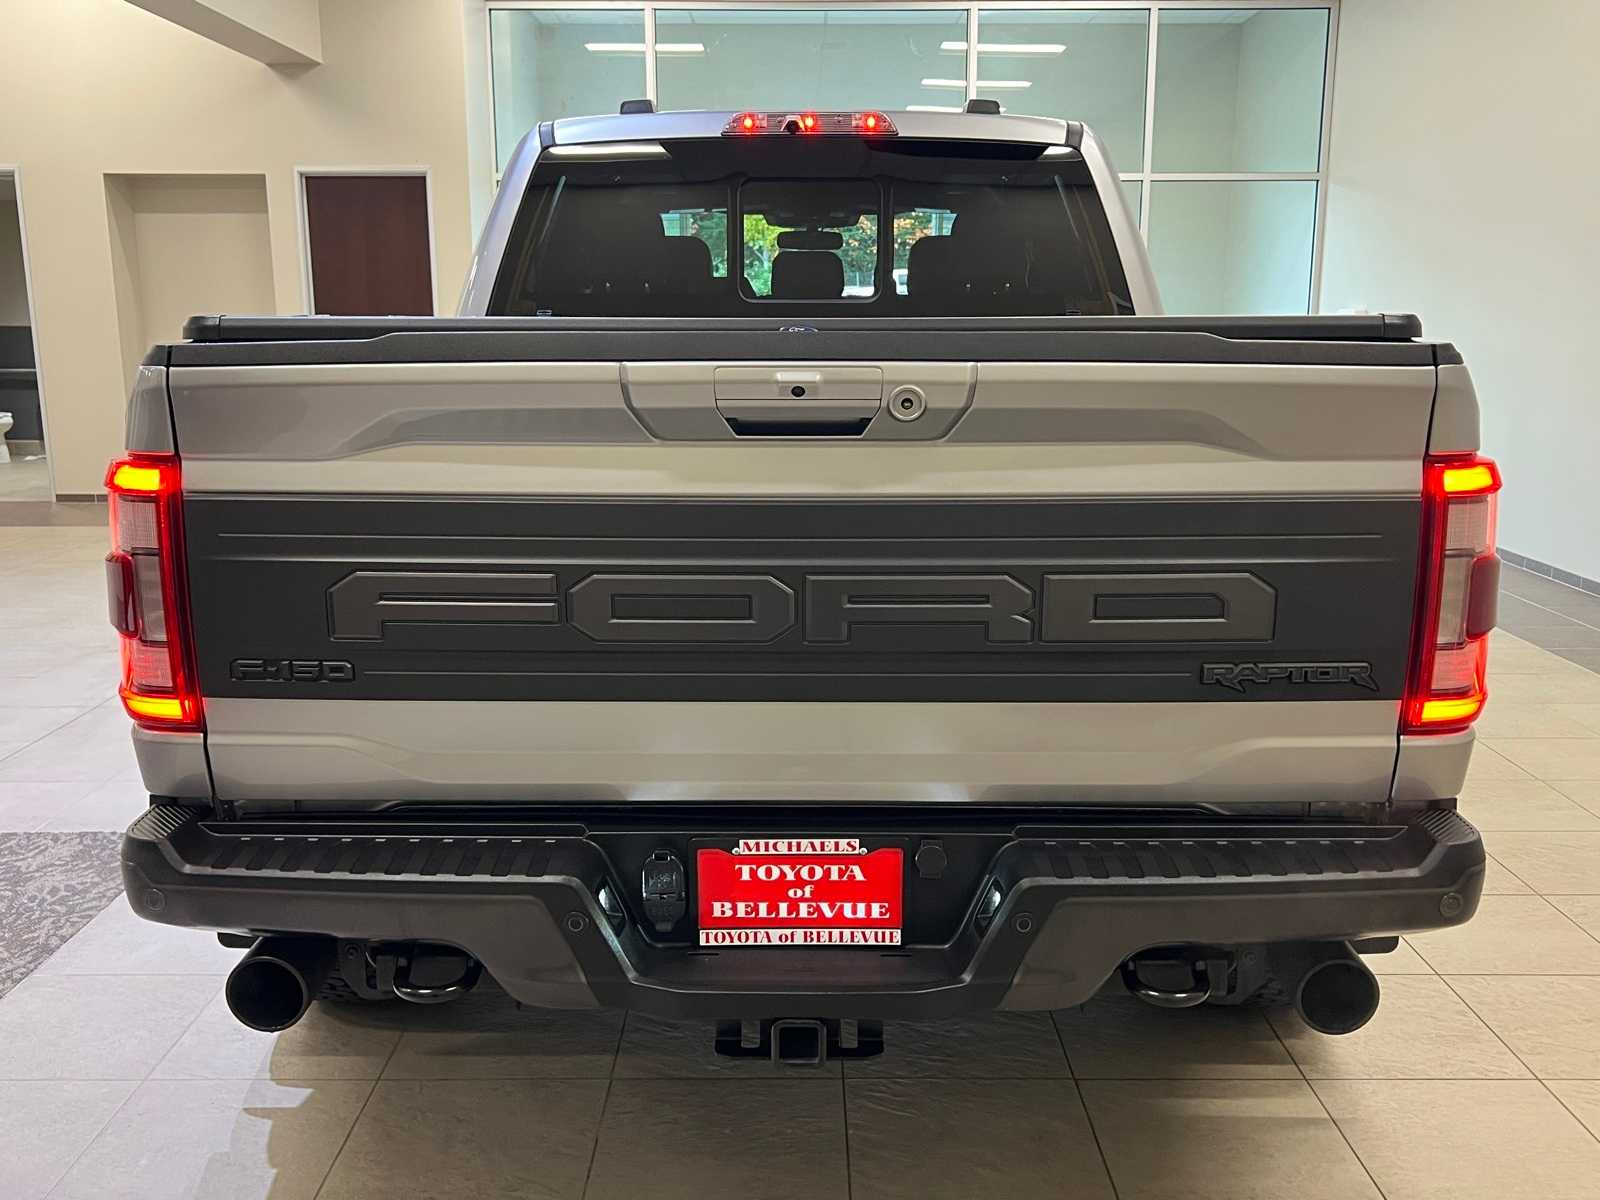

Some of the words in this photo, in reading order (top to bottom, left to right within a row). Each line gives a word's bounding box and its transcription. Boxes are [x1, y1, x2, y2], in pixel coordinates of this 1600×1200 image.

[328, 570, 1277, 644] FORD
[231, 659, 355, 681] F-150
[1202, 661, 1378, 691] RAPTOR
[742, 840, 858, 852] MICHAELS
[735, 864, 866, 881] TOYOTA
[787, 885, 815, 898] of
[711, 902, 890, 918] BELLEVUE
[701, 931, 772, 944] TOYOTA
[778, 931, 797, 944] of
[803, 931, 899, 944] BELLEVUE
